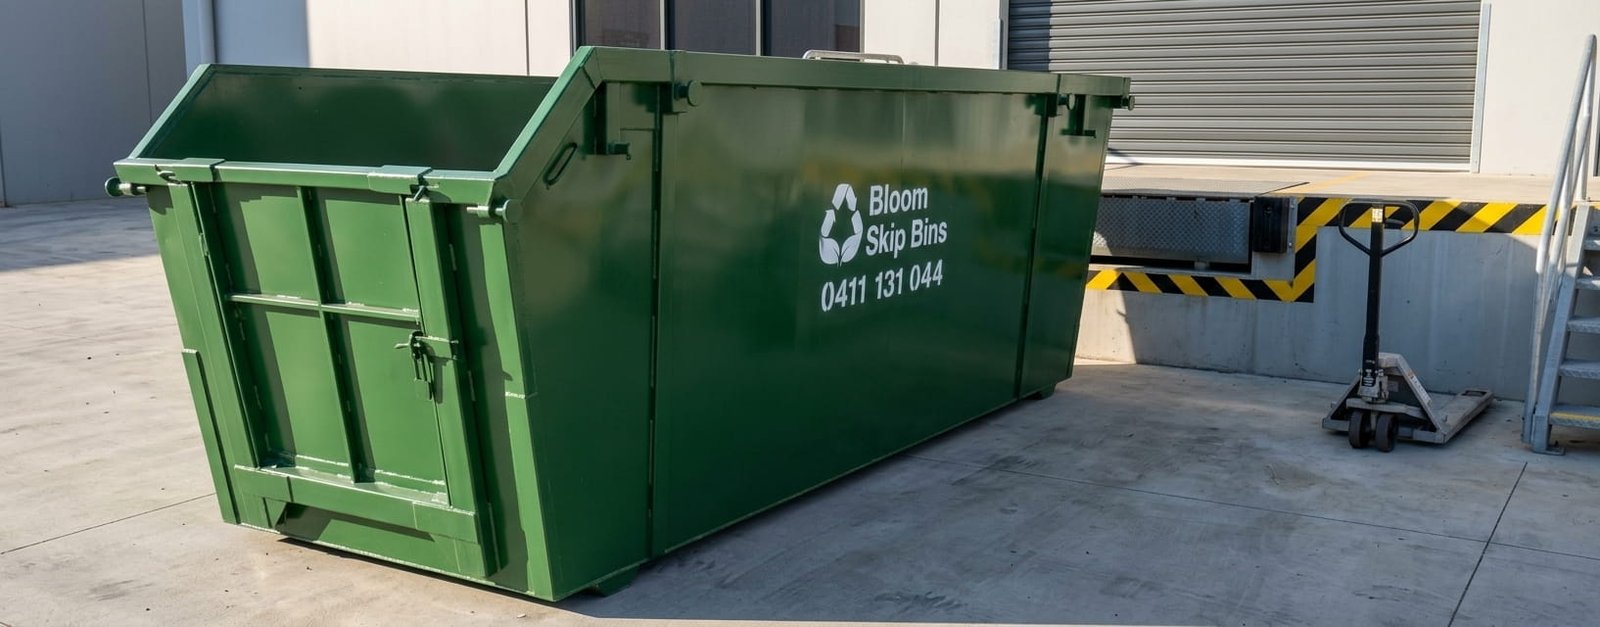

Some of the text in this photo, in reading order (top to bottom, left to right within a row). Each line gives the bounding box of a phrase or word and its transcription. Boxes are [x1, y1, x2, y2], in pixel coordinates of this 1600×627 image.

[869, 184, 928, 216] Bloom
[866, 217, 948, 259] Skip Bins
[821, 259, 943, 312] 0411 131 044
